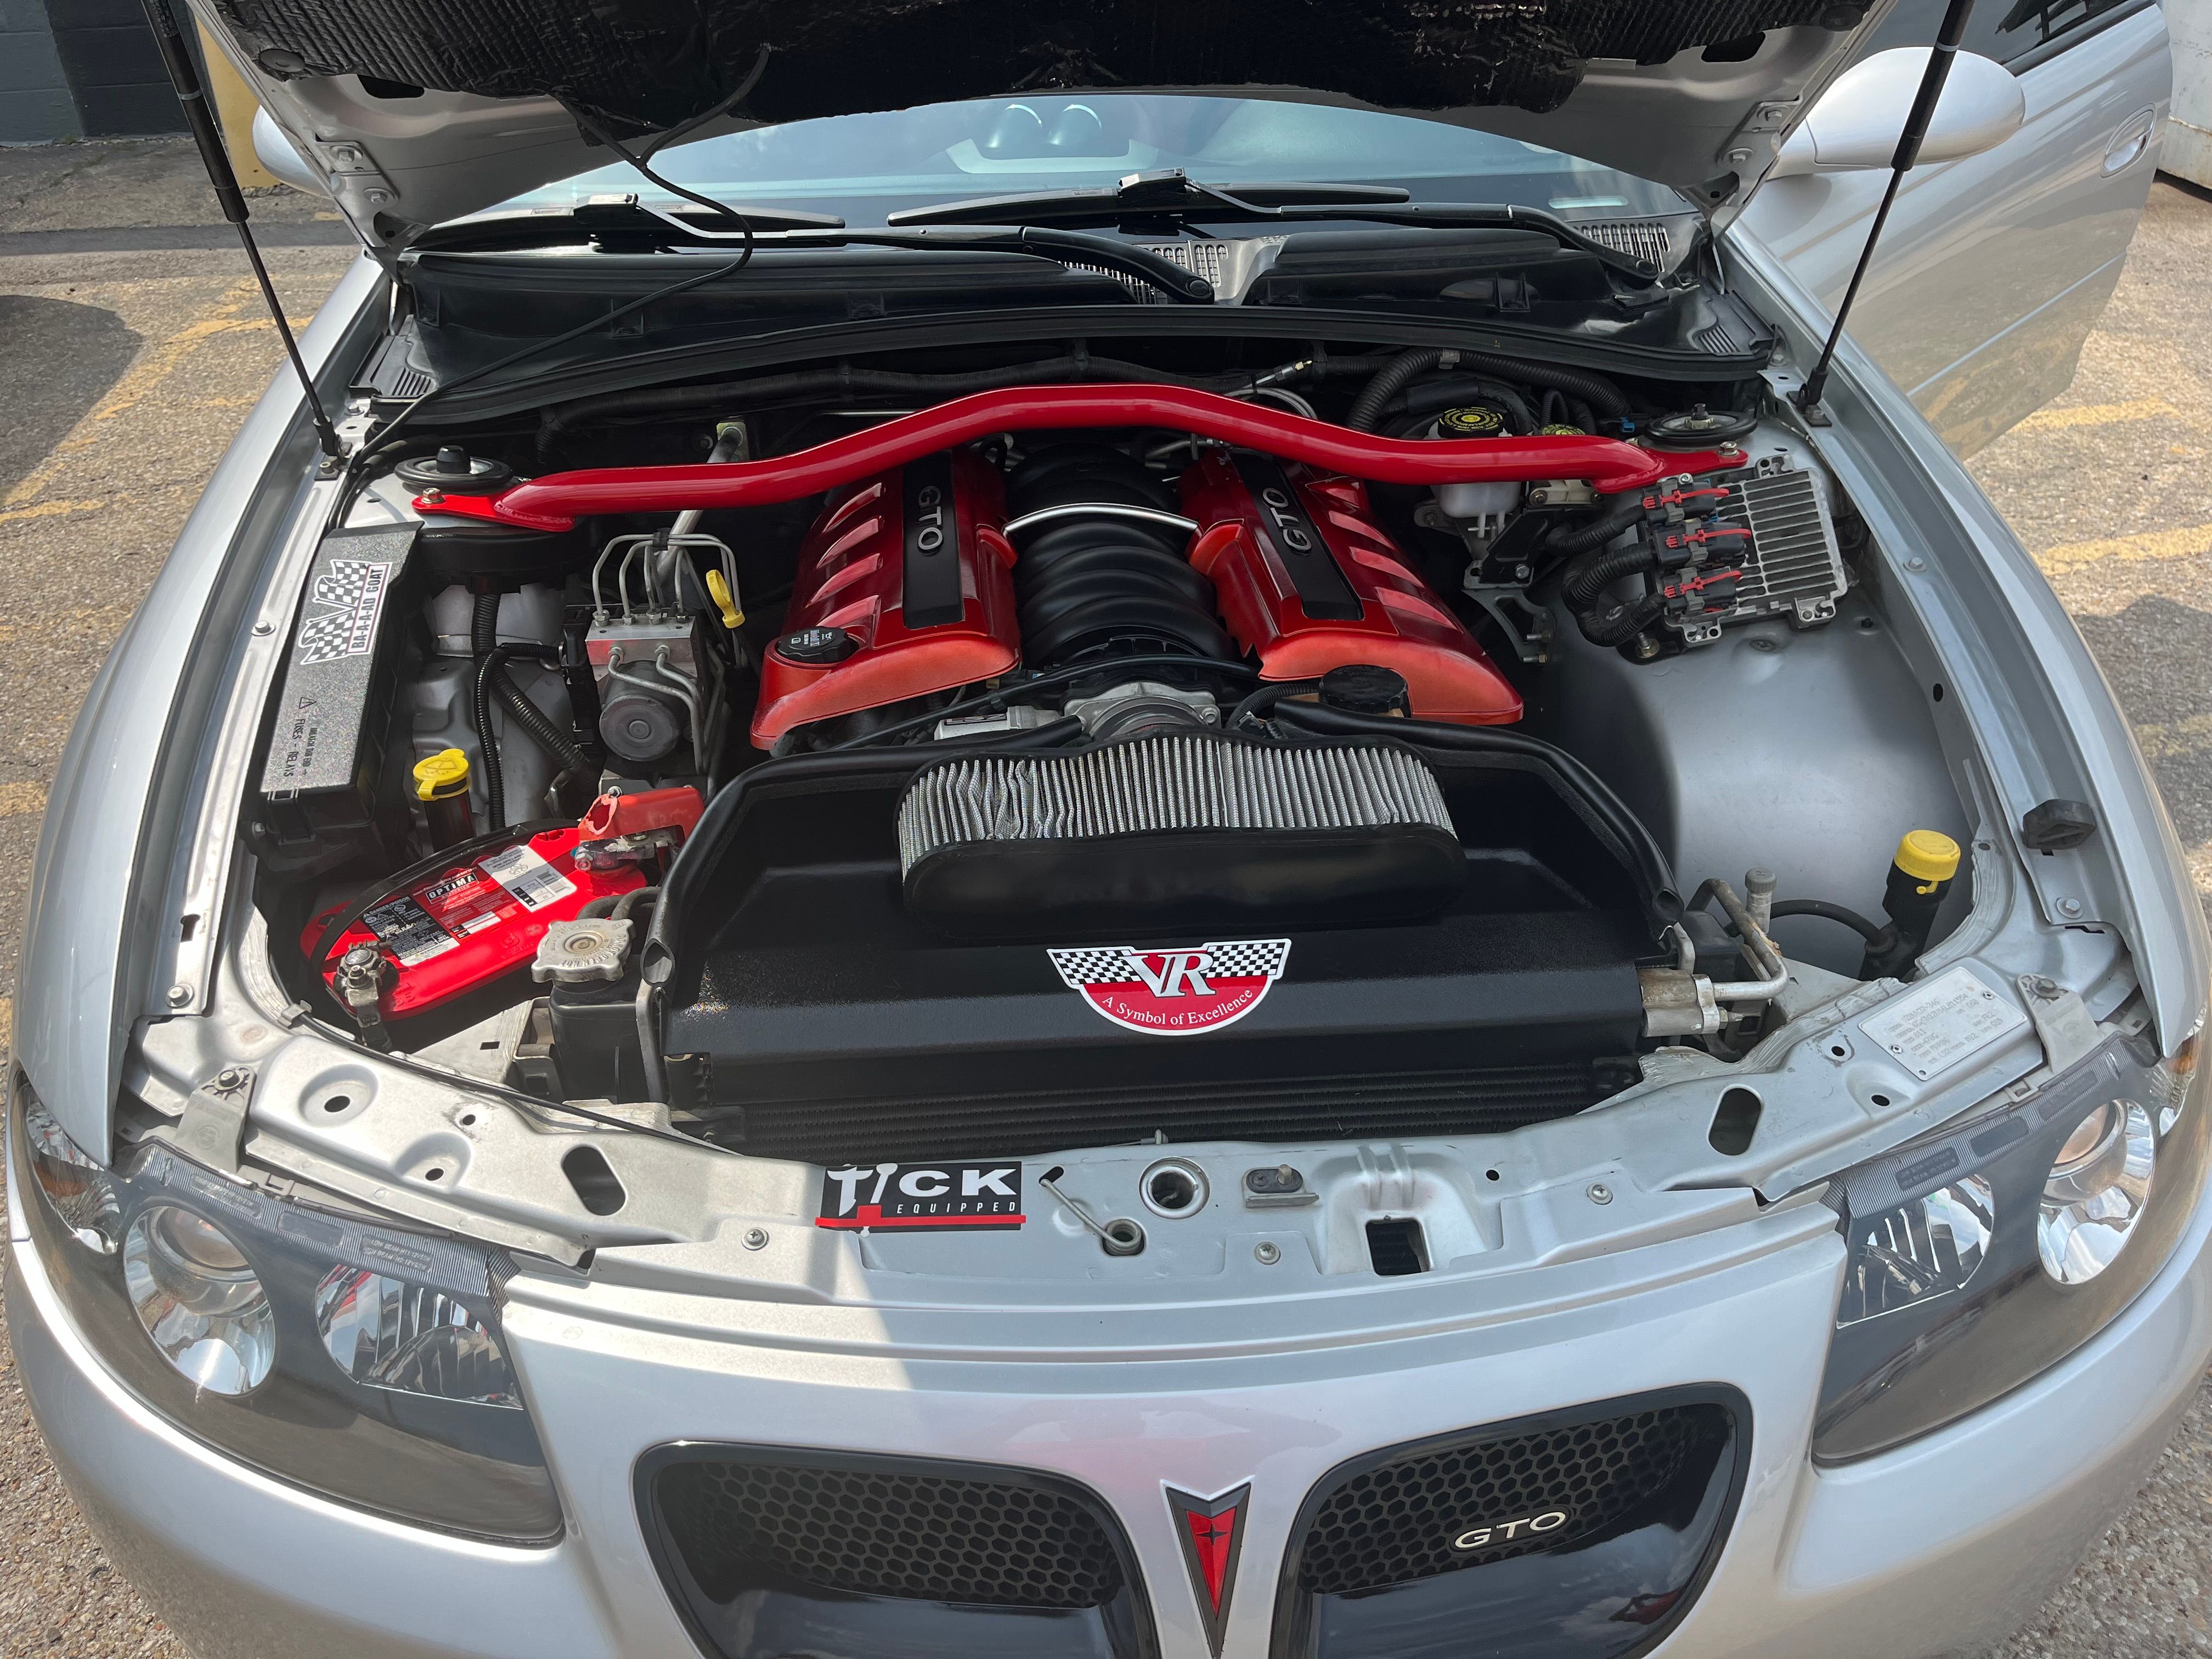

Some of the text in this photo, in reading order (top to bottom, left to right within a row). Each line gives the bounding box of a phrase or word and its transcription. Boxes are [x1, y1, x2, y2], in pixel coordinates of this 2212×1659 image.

[918, 486, 943, 550] GTO
[1262, 487, 1312, 551] GTO
[351, 569, 383, 648] BA-A-A-AD GOAT
[292, 719, 306, 740] FUSES
[283, 751, 299, 777] RELAYS
[428, 875, 476, 899] OPTIMA
[1118, 953, 1216, 997] VR
[1102, 989, 1253, 1025] A Symbol of Excellence
[827, 1163, 1018, 1217] TICK
[896, 1201, 1016, 1214] EQUIPPED
[362, 1246, 377, 1255] HIGH
[1455, 1511, 1566, 1548] GTO
